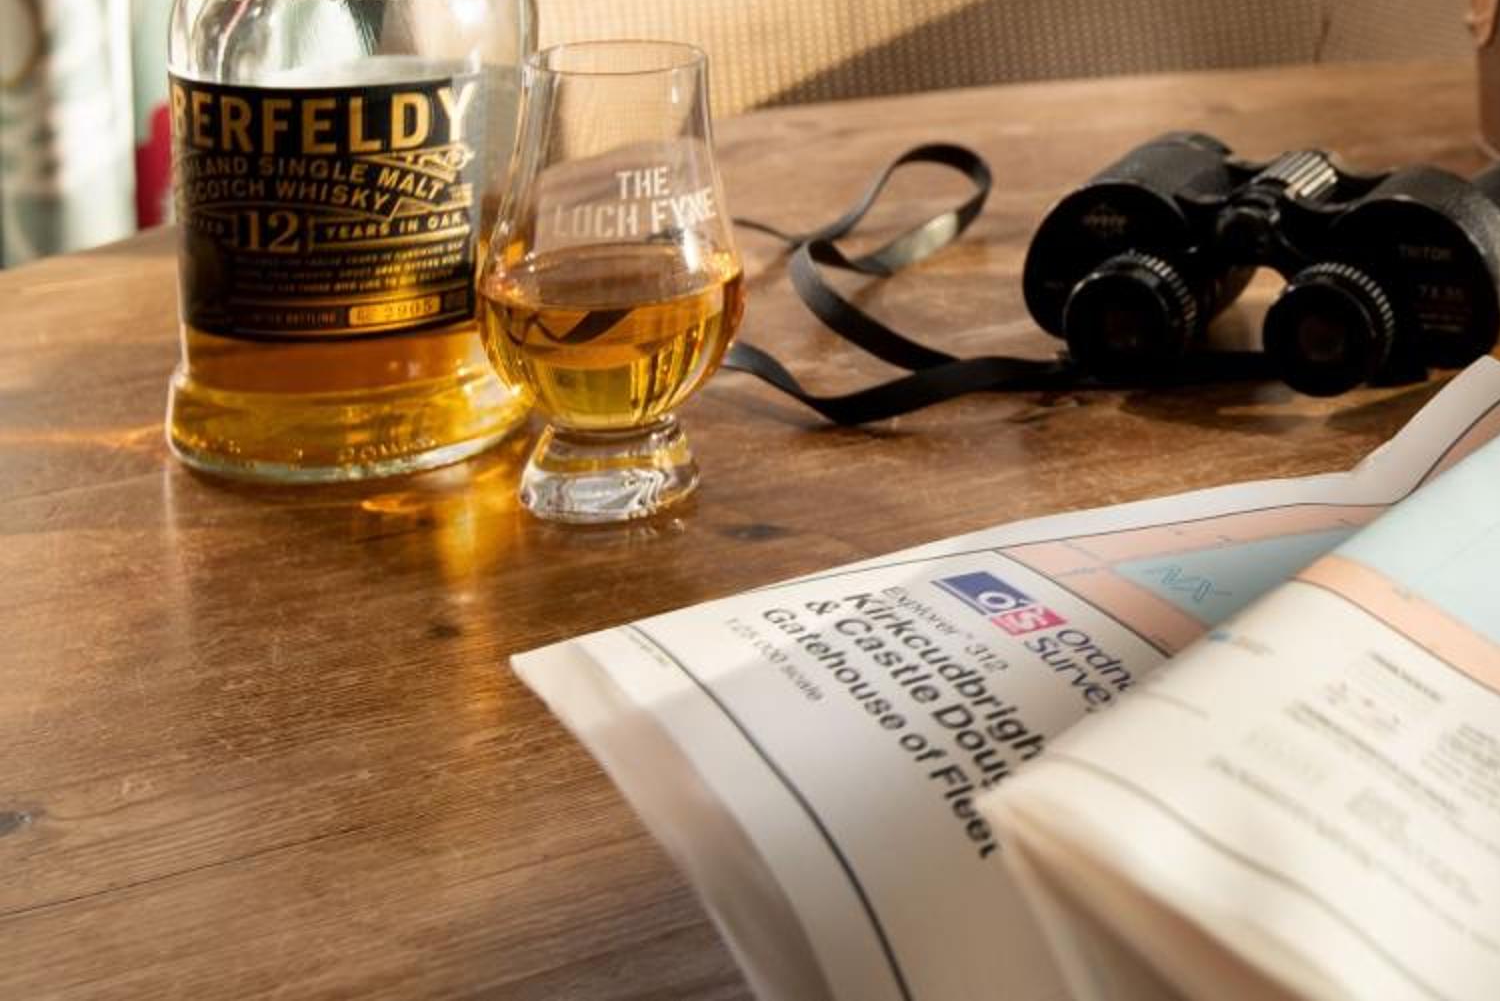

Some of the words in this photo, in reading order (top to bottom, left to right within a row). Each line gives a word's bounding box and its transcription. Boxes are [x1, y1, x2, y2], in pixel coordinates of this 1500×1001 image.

[172, 82, 475, 155] BERFELDY
[187, 154, 249, 177] LAND
[258, 155, 368, 183] SINGLE
[378, 166, 445, 200] MALT
[275, 180, 390, 211] WHISKY
[616, 166, 671, 199] THE
[244, 210, 299, 252] 12
[327, 220, 390, 239] YEARS
[552, 201, 638, 238] LOCH
[651, 186, 717, 234] FYNE
[804, 600, 841, 616] &
[834, 618, 941, 704] Castle
[843, 592, 1045, 762] Kirkcudbrigh
[1024, 635, 1113, 713] Surve
[1056, 629, 1134, 691] Ordn
[762, 607, 907, 731] Gatehouse
[899, 732, 948, 763] of
